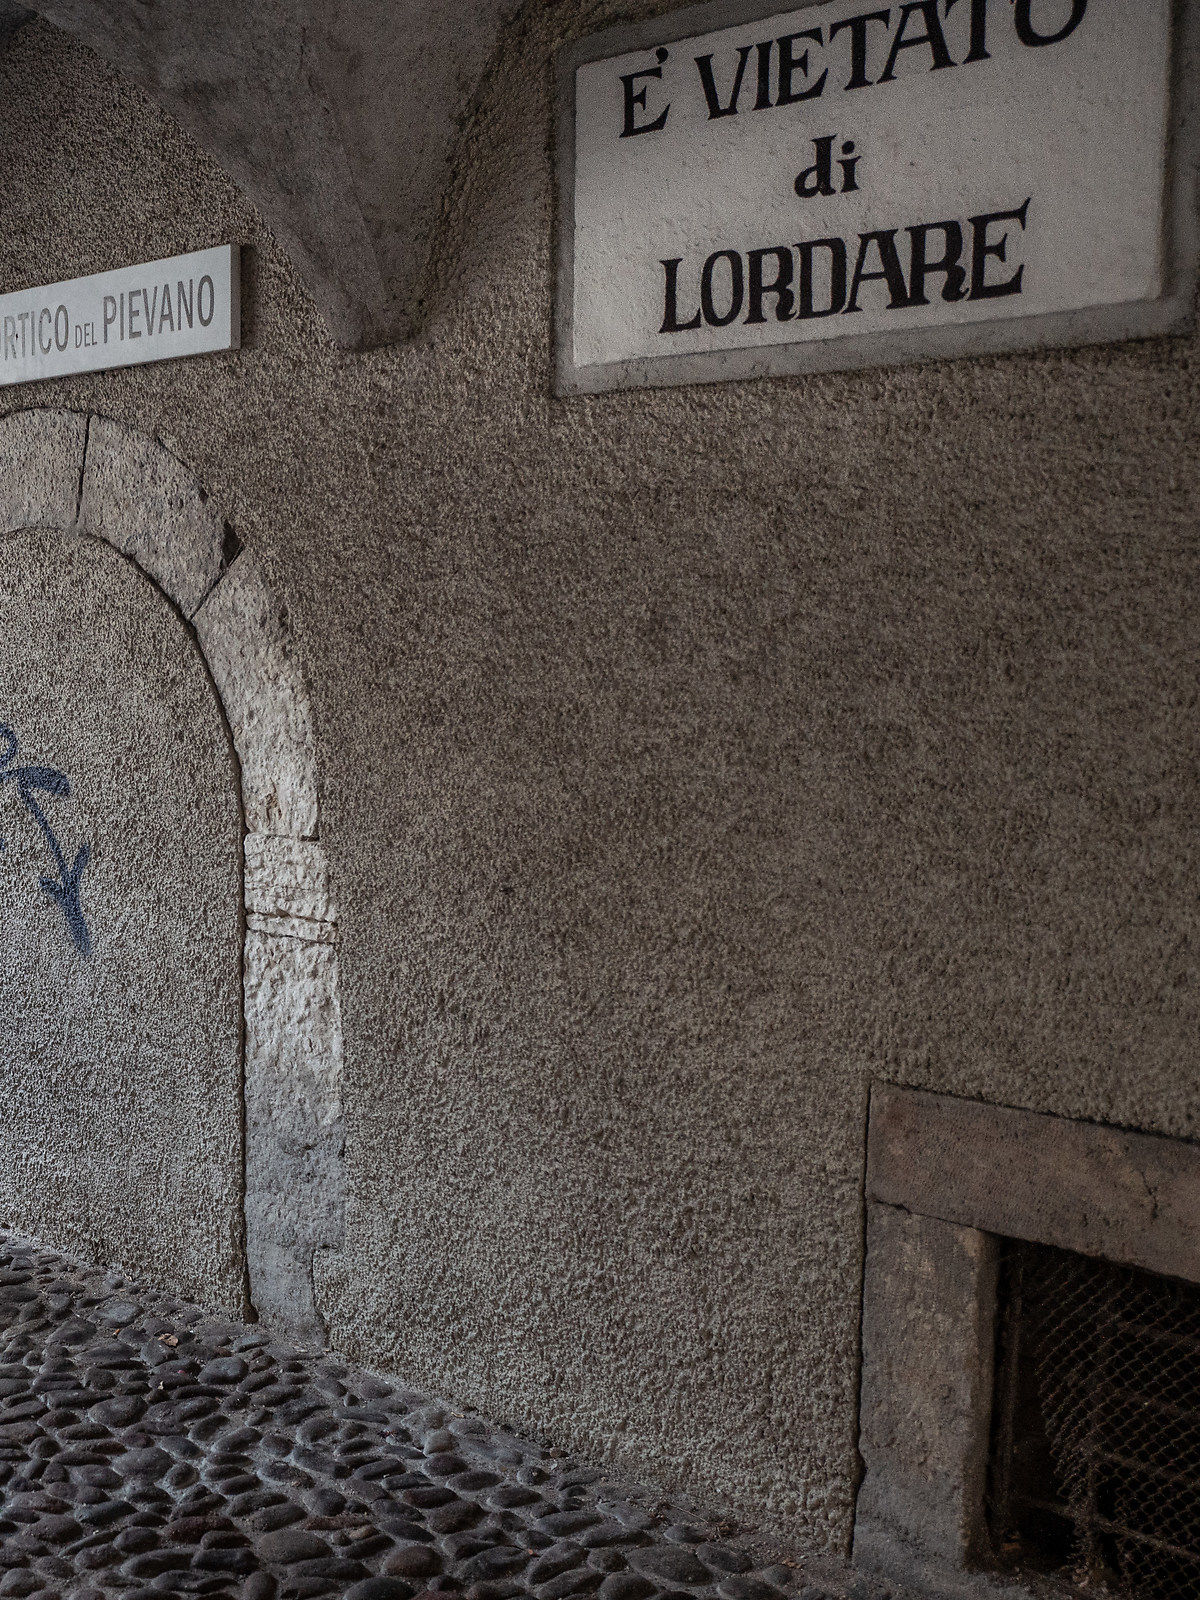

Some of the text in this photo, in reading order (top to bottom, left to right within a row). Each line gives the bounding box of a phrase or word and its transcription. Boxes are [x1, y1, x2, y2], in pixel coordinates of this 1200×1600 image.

[693, 0, 1088, 121] VIETATO
[793, 134, 862, 199] di
[74, 320, 98, 349] DEL
[102, 274, 216, 344] PIEVANO
[658, 197, 1032, 334] LORDARE
